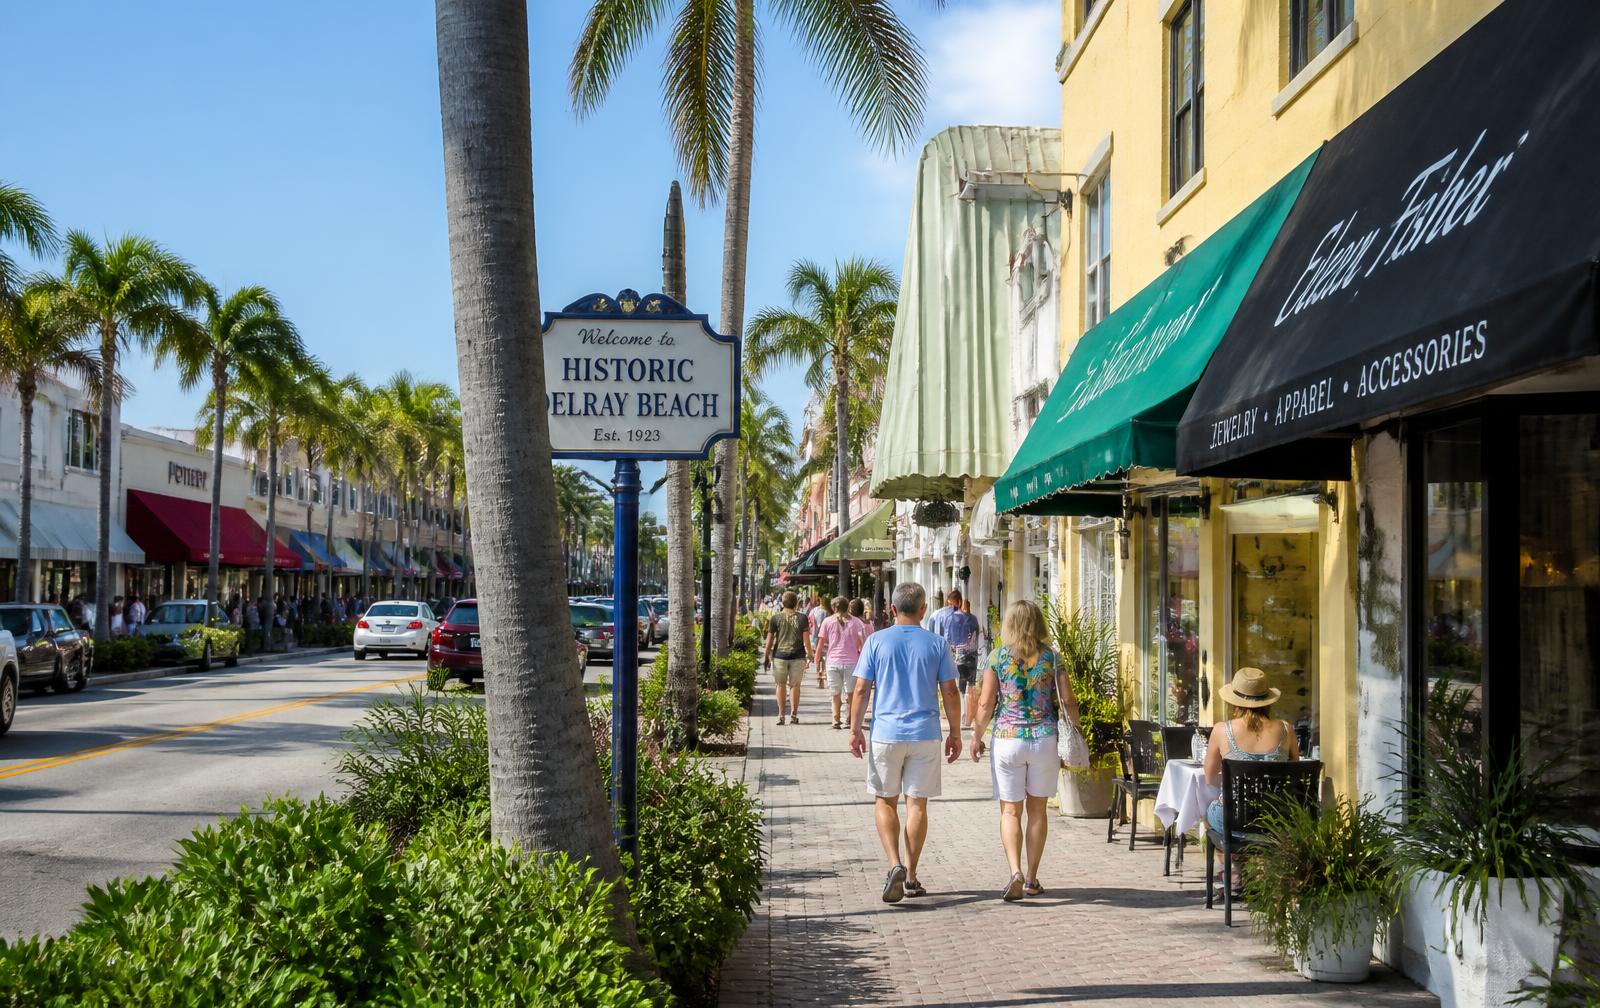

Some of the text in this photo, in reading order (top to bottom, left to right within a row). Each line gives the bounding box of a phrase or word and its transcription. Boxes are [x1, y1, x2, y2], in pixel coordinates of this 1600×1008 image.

[577, 327, 676, 346] Welcome to
[562, 357, 694, 383] HISTORIC
[1356, 319, 1488, 398] ACCESSORIES
[546, 392, 719, 418] ELRAY BEACH
[593, 428, 661, 442] Est. 1923
